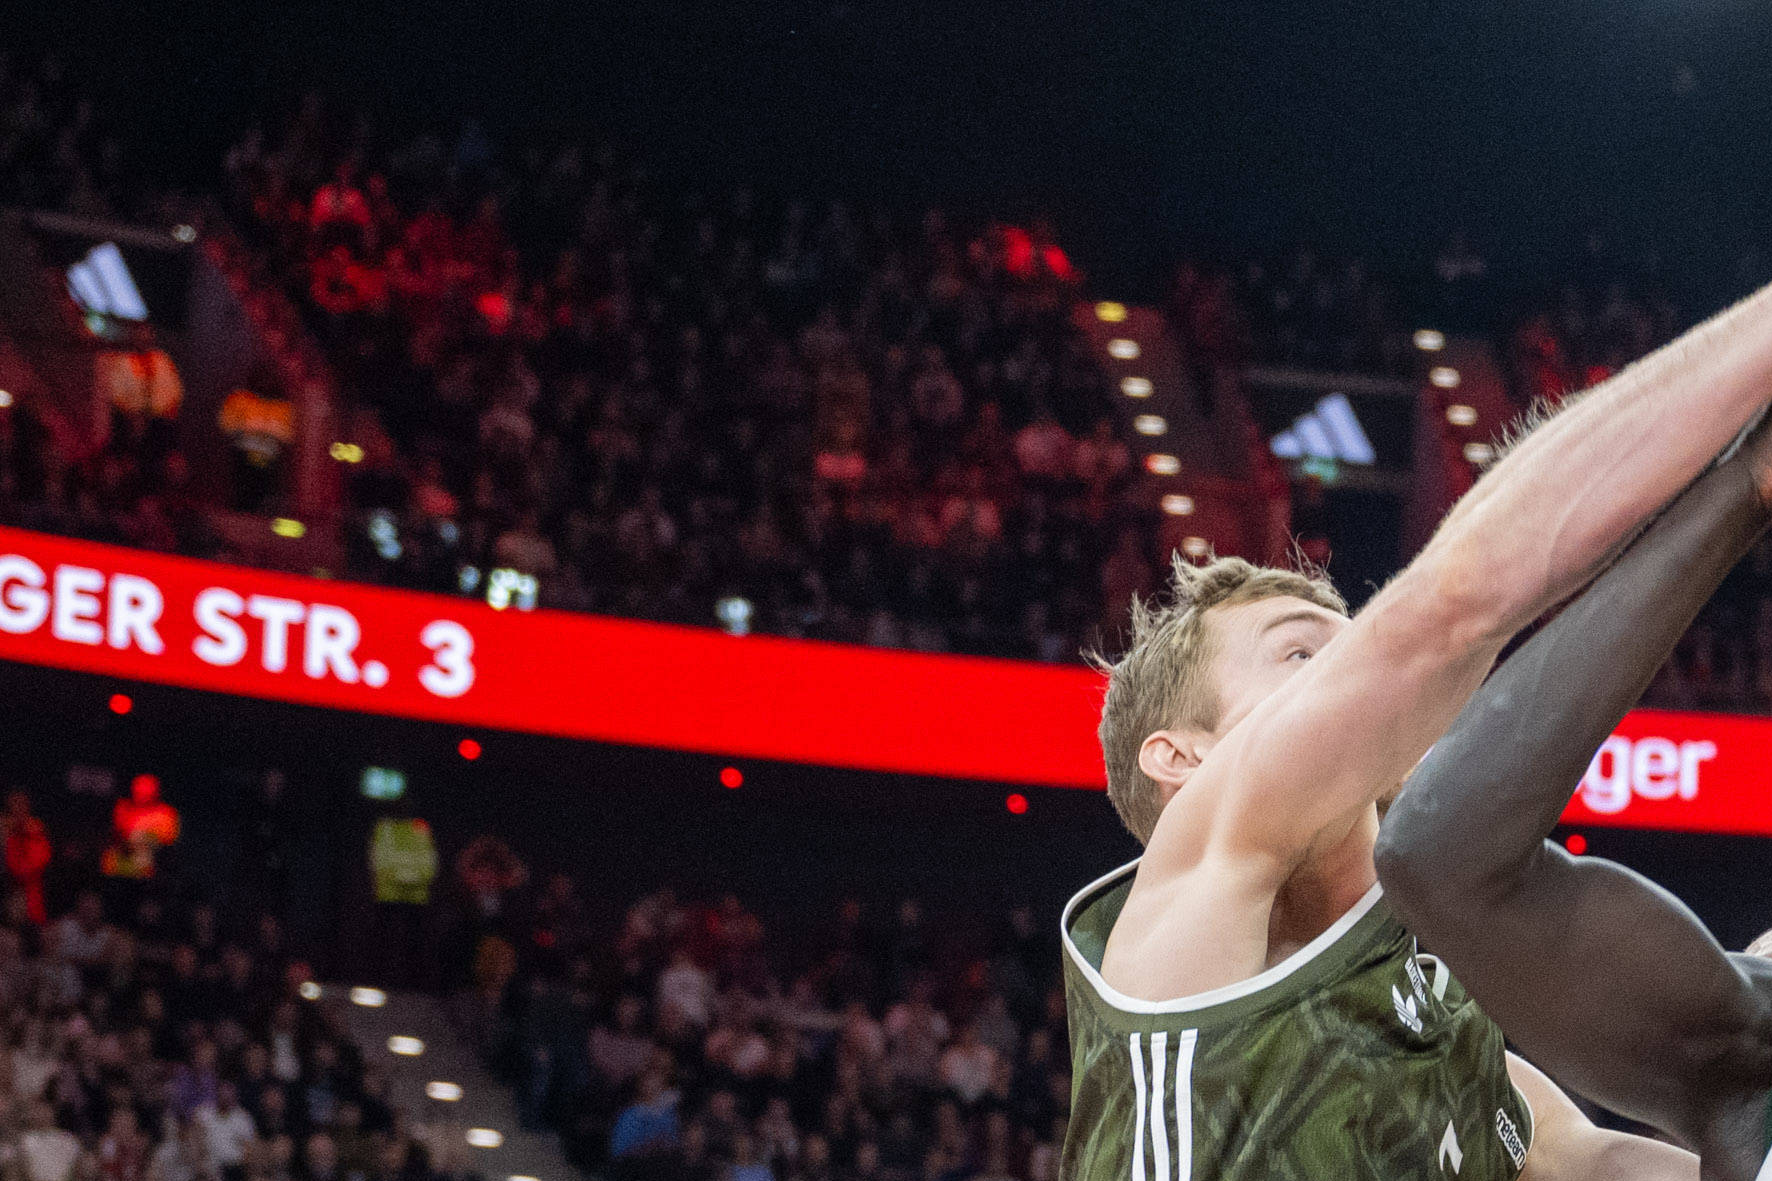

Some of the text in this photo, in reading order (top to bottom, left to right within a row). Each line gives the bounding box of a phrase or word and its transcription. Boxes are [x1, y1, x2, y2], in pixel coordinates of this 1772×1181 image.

[0, 554, 475, 697] GER STR. 3
[1577, 735, 1718, 814] ger
